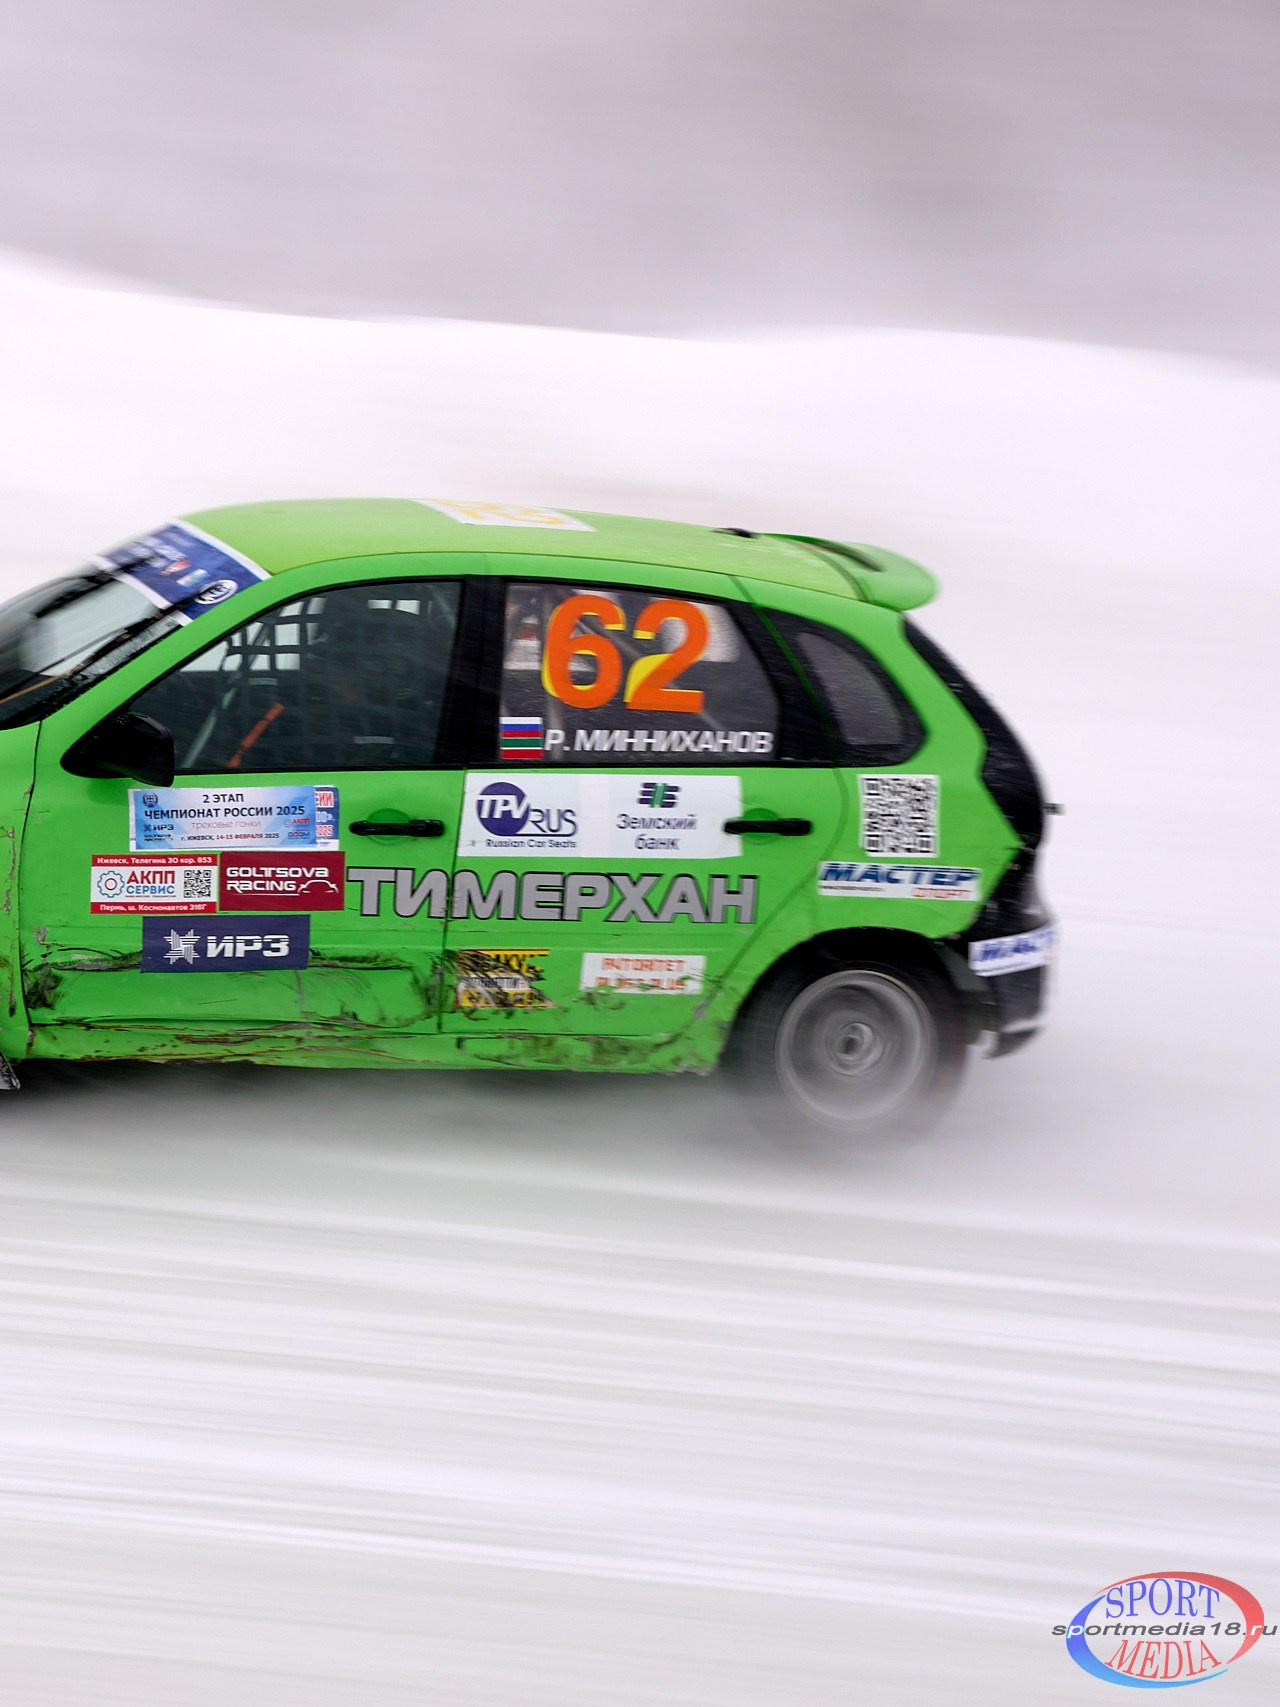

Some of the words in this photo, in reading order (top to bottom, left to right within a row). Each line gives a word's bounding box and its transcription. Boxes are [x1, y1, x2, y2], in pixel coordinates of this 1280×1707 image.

[541, 594, 709, 713] 62
[544, 730, 569, 751] Р.
[573, 730, 773, 753] МИННИХАНОВ
[203, 795, 210, 803] 2
[213, 794, 244, 803] ЭТАП
[145, 808, 220, 819] ЧЕМПИОНАТ
[224, 807, 273, 817] РОССИИ
[276, 806, 305, 815] 2025
[192, 821, 232, 830] трековые
[235, 820, 261, 828] гонки
[616, 813, 697, 830] Земский
[486, 839, 525, 848] Russian
[527, 839, 545, 848] Car
[547, 839, 577, 848] Seats
[635, 833, 680, 850] банк
[127, 870, 175, 884] АКПП
[821, 863, 981, 886] МАСТЕР
[126, 886, 175, 894] СЕРВИС
[347, 866, 759, 923] ТИМЕРХАН
[100, 904, 127, 912] Пермь,
[207, 934, 290, 958] ИРЗ
